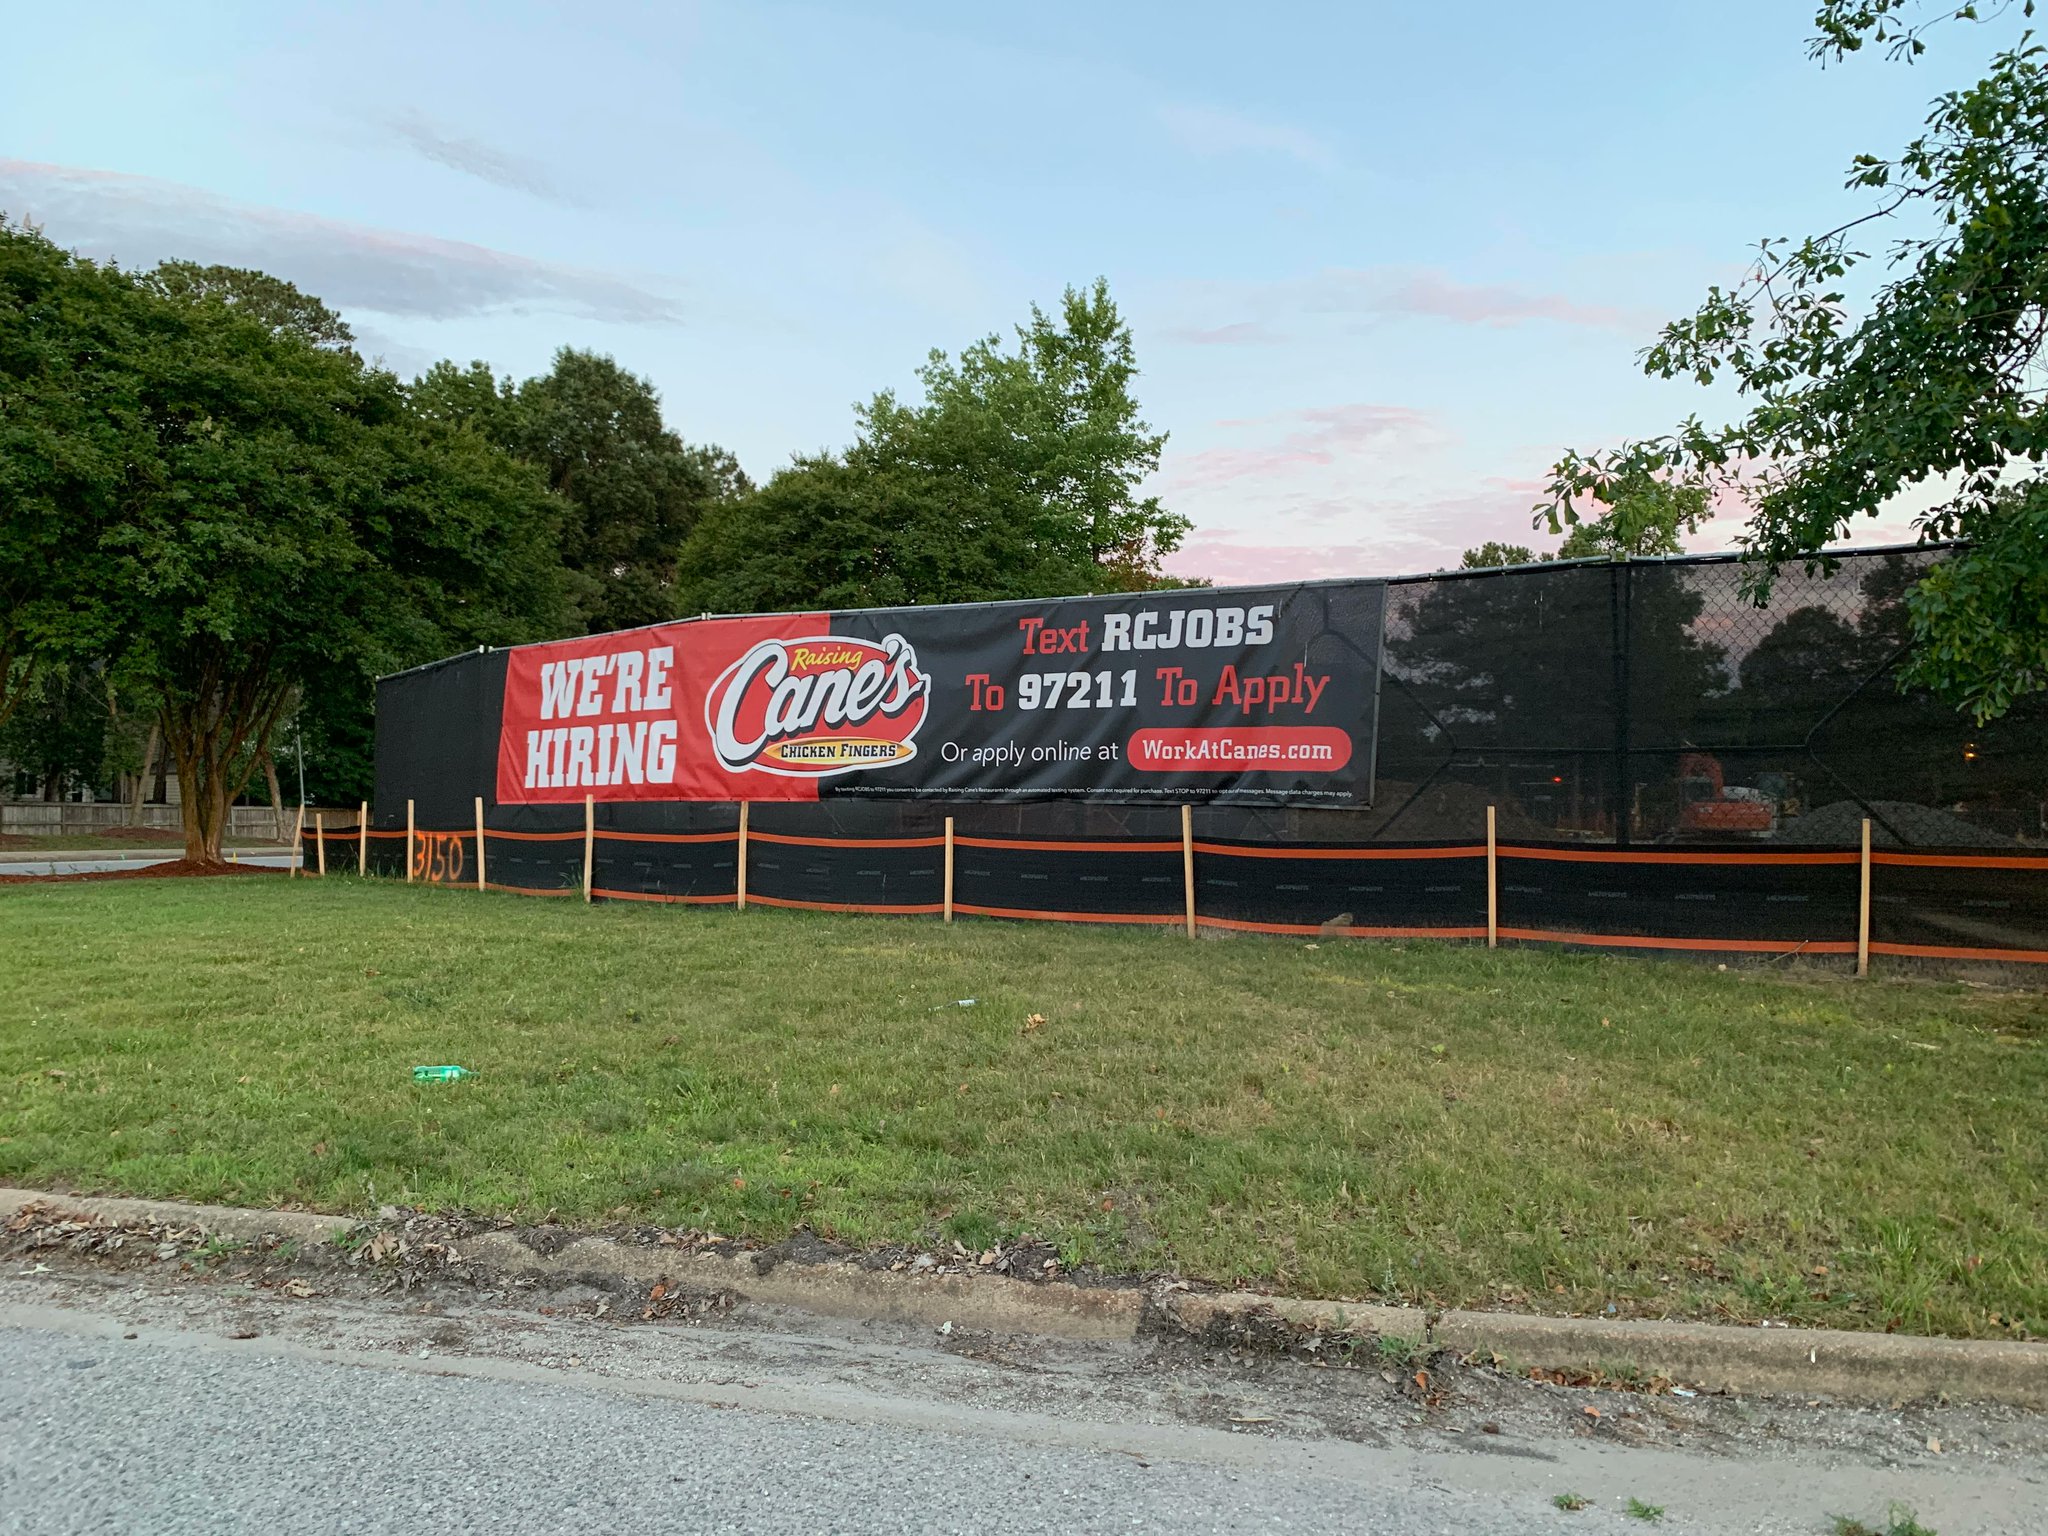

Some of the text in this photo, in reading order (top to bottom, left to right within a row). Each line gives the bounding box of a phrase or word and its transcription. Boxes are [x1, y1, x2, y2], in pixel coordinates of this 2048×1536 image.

[1019, 605, 1274, 655] Text RCJOBS
[540, 646, 674, 720] WE'RE
[791, 648, 862, 671] Raising
[715, 639, 925, 762] Cane's
[965, 662, 1330, 715] To 97211 To Apply
[525, 720, 677, 788] HIRING
[941, 738, 1333, 767] Or apply online at WorkAtCanes.com
[413, 833, 463, 881] 3150
